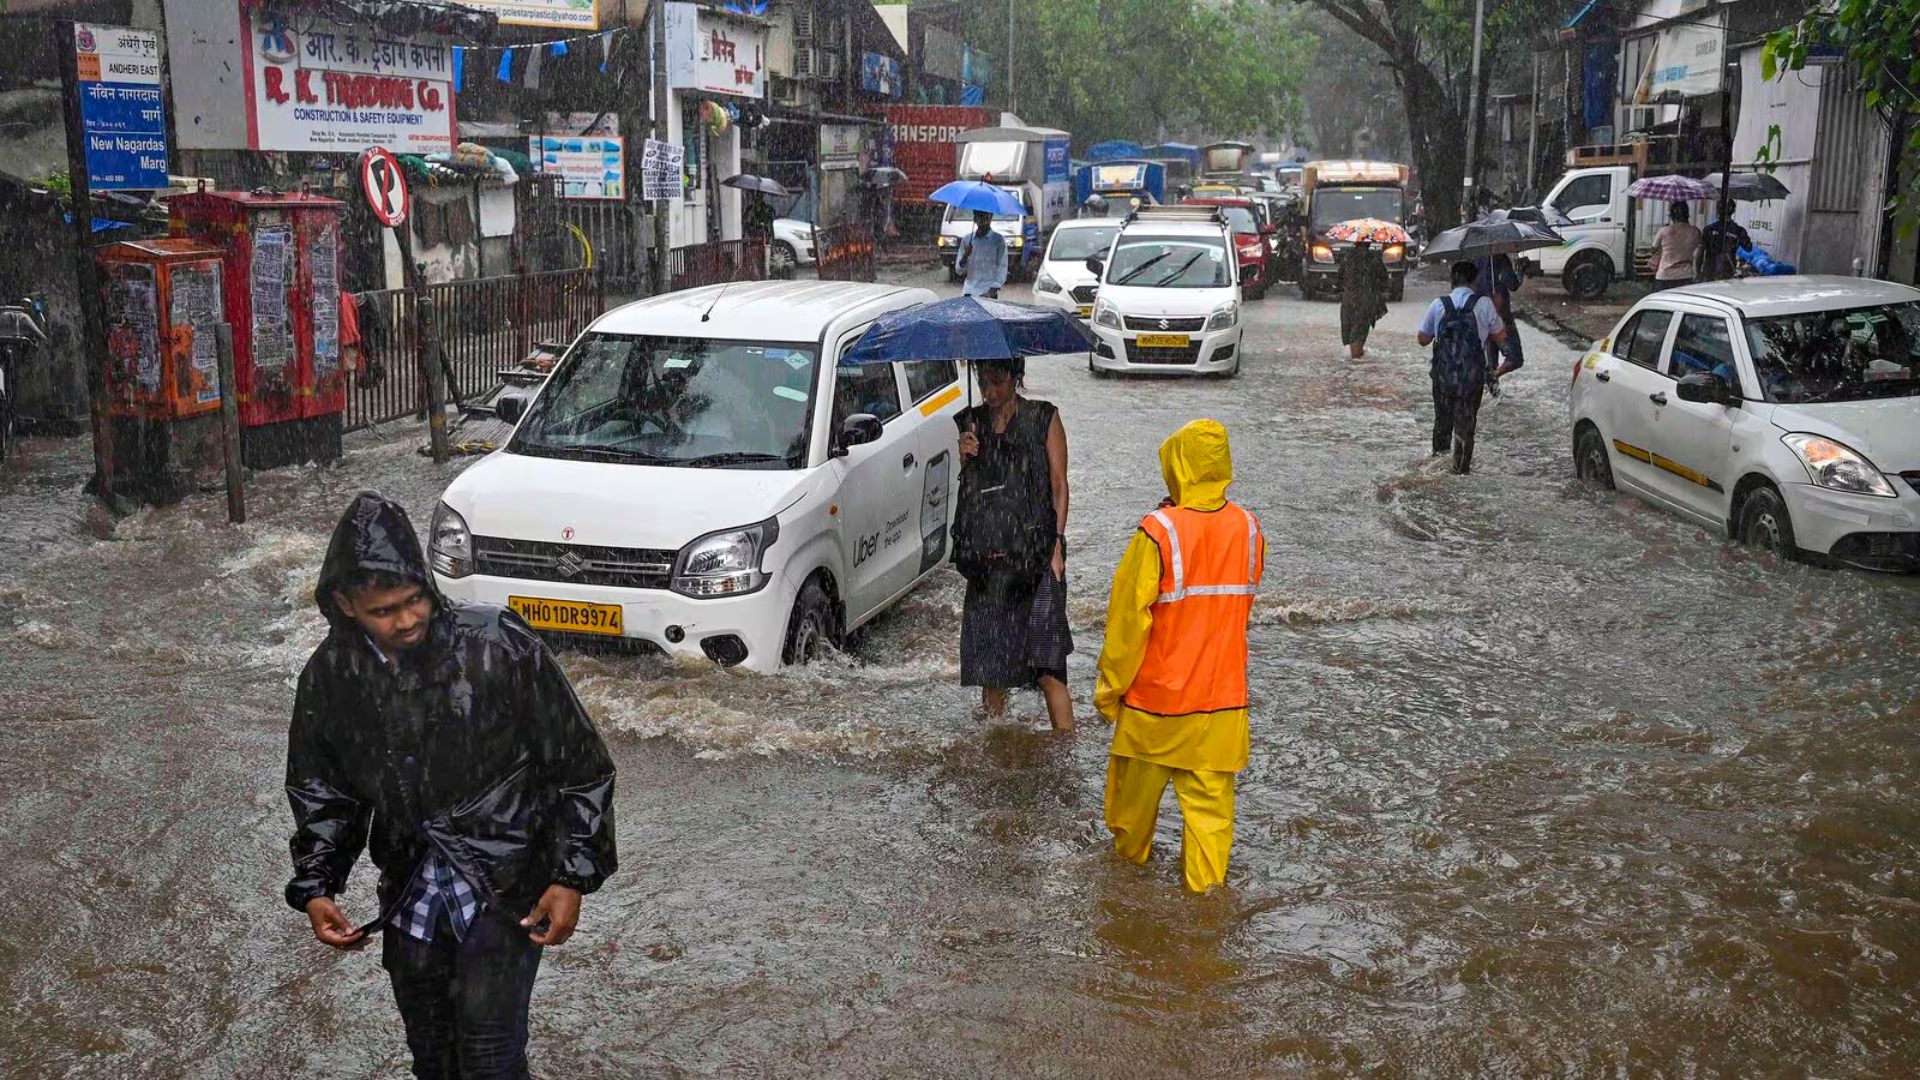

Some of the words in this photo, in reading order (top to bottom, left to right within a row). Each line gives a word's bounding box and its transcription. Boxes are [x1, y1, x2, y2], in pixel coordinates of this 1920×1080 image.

[109, 63, 140, 75] ANDHERI
[140, 65, 159, 76] EAST
[117, 88, 160, 103] नागरदास
[264, 66, 290, 105] R.
[294, 67, 319, 104] K.
[322, 70, 415, 110] TRADING
[417, 80, 445, 112] Co.
[141, 105, 162, 122] मार्ग
[294, 108, 351, 123] CONSTRUCTION
[352, 112, 359, 123] &
[359, 112, 385, 125] SAFETY
[387, 114, 423, 126] EQUIPMENT
[892, 125, 967, 142] RANSPORT
[90, 136, 114, 151] New
[115, 136, 164, 154] Nagardas
[140, 155, 166, 173] Marg
[852, 531, 880, 569] Uber
[522, 602, 618, 629] MH01DR9974
